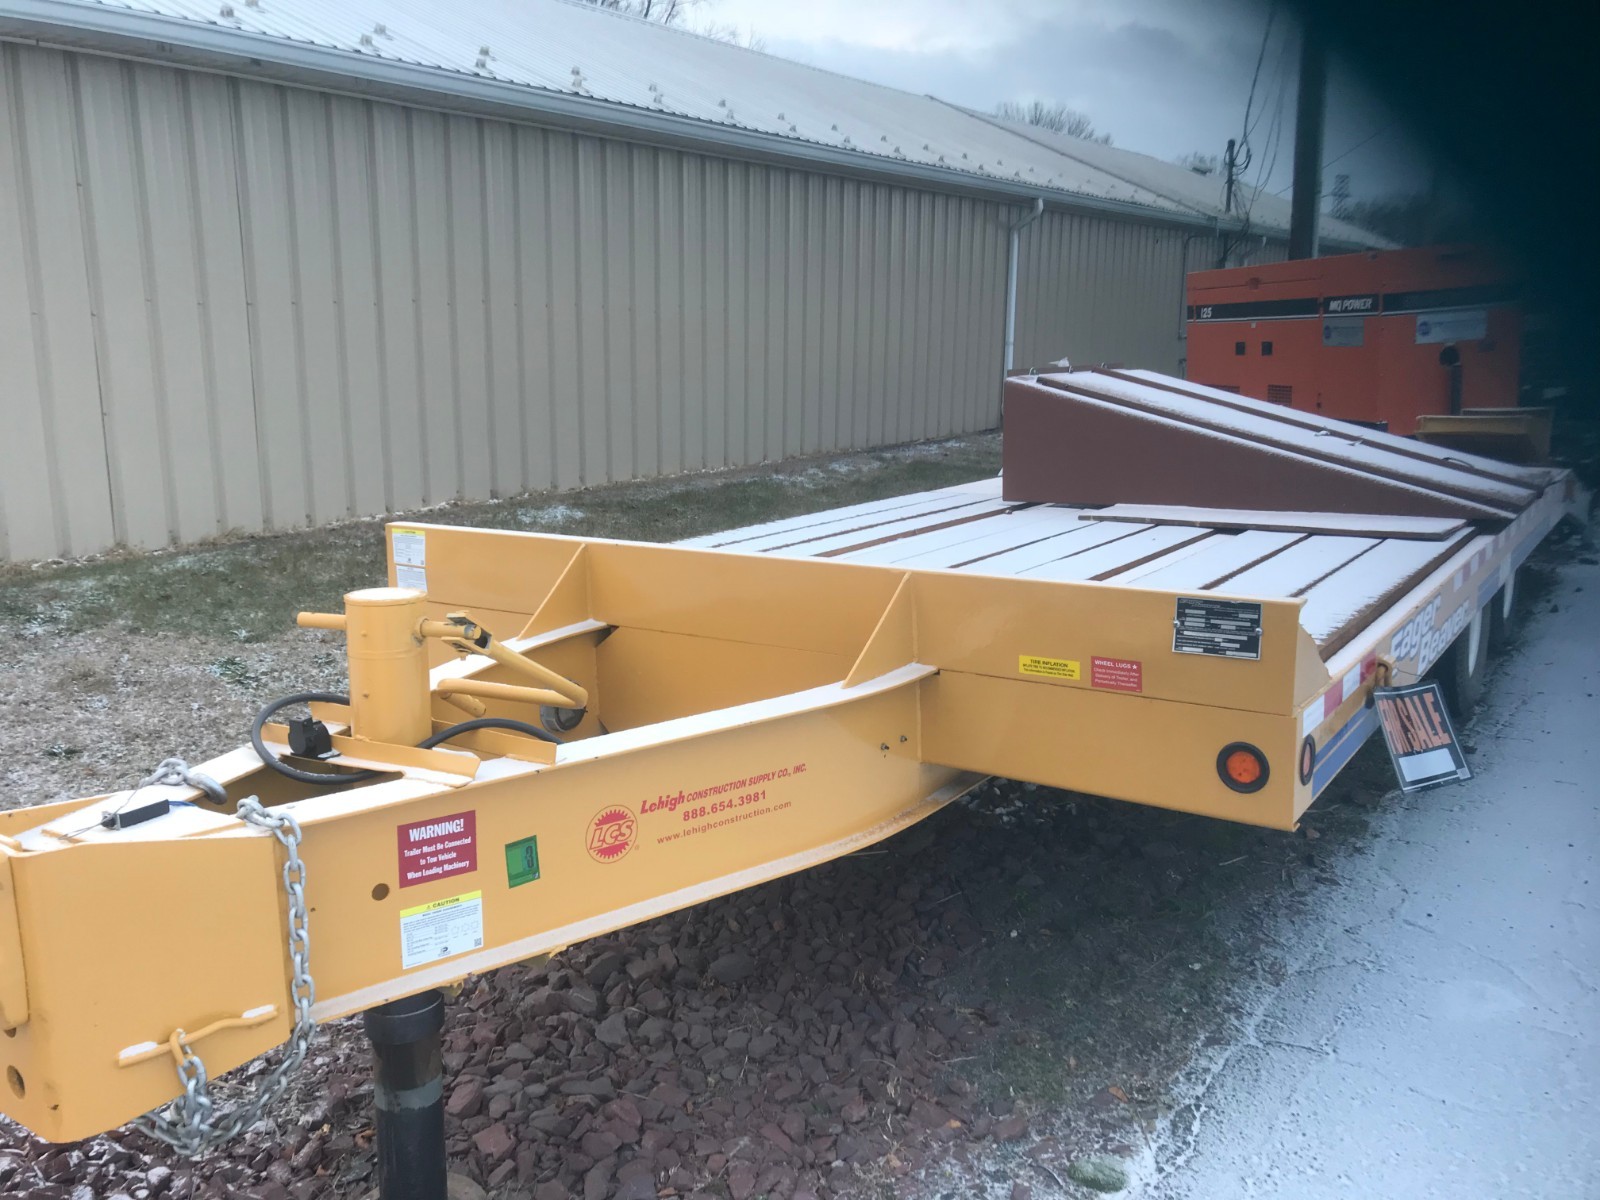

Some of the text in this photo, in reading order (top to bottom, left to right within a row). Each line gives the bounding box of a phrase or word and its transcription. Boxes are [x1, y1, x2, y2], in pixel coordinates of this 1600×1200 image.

[1329, 298, 1372, 312] MQ POWER
[1390, 593, 1441, 660] Eager
[1417, 598, 1470, 676] Beaver
[1042, 660, 1068, 668] INFLATION
[1094, 659, 1115, 667] WHEEL
[1394, 691, 1452, 752] SALE
[640, 790, 686, 815] Lehigh
[686, 778, 748, 802] CONSTRUCTION
[748, 770, 778, 787] SUPPLY
[793, 763, 807, 775] INC.
[682, 789, 767, 822] 888.654.3981
[408, 818, 464, 842] WARNING!
[589, 819, 635, 850] LCS
[656, 800, 792, 845] www.lehighconstruction.com
[404, 836, 472, 857] Trailer Must Be Connected
[420, 851, 457, 866] to Tow Vehicle
[406, 860, 470, 880] When Loading Machinery
[432, 897, 460, 908] CAUTION
